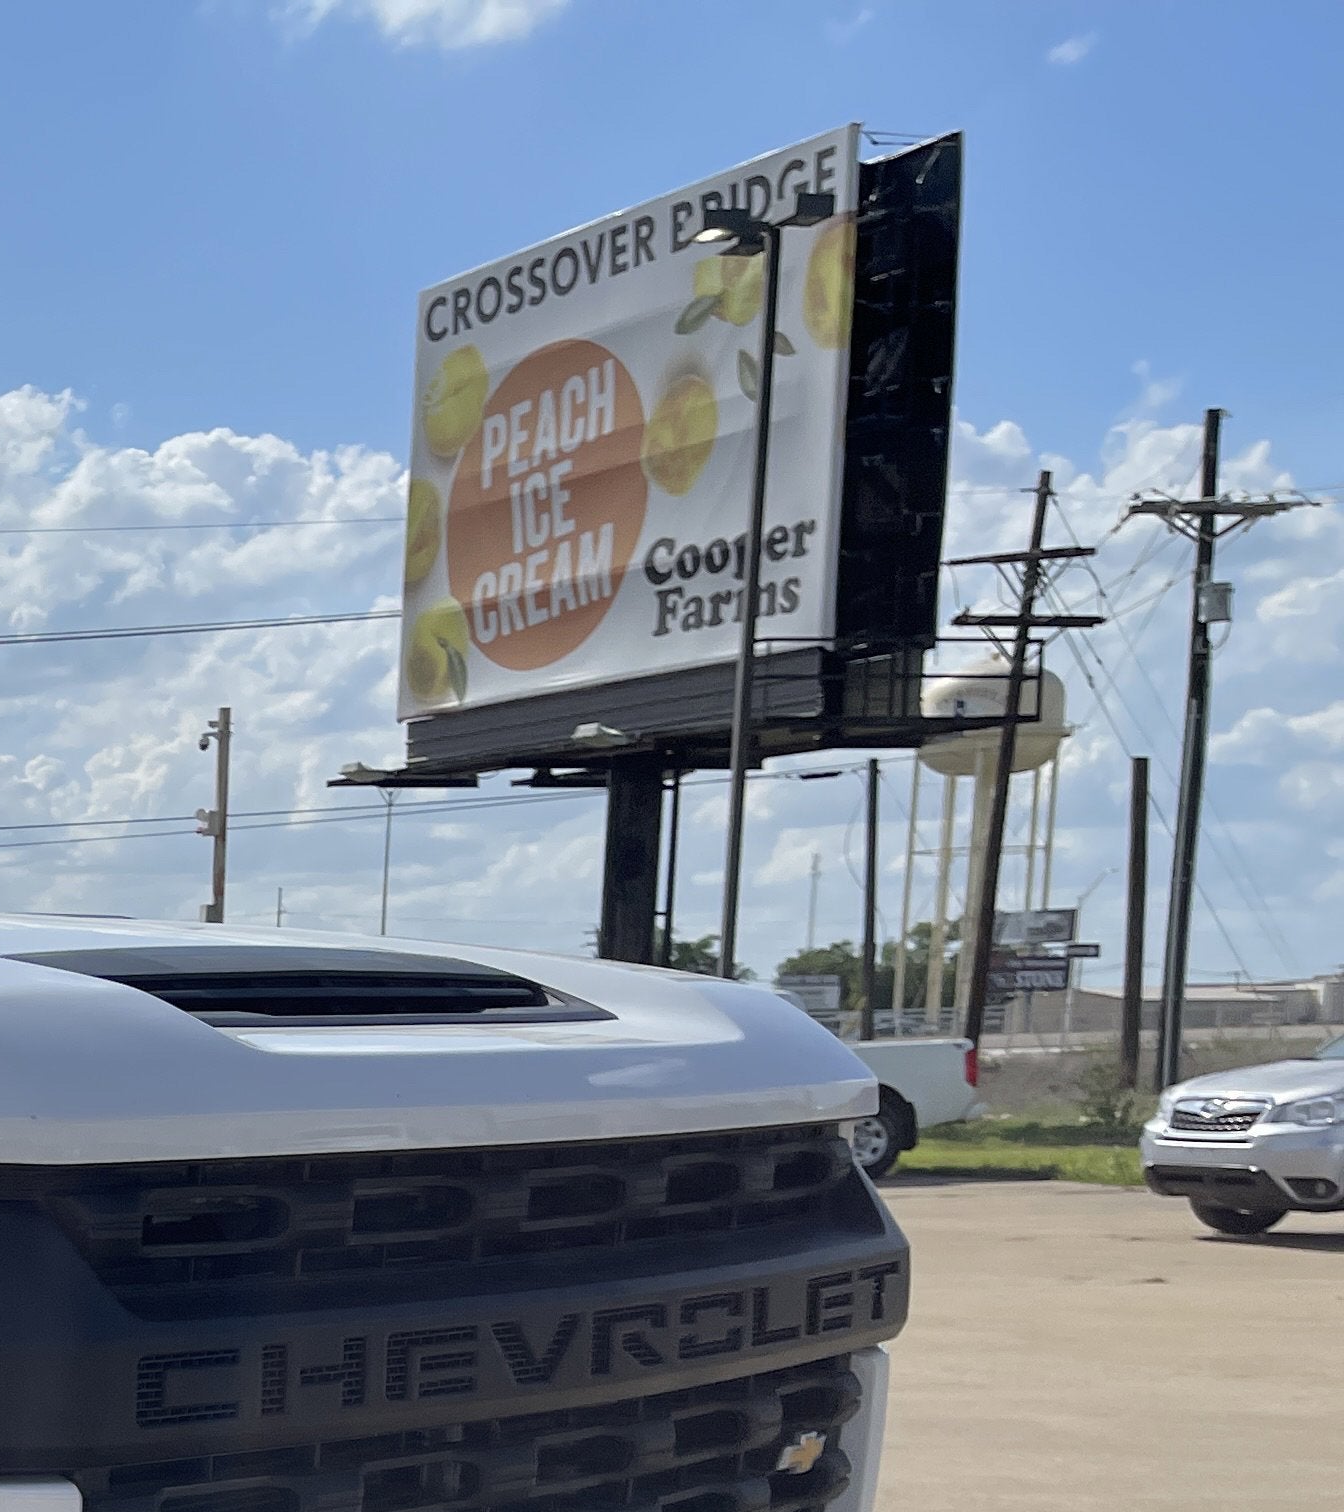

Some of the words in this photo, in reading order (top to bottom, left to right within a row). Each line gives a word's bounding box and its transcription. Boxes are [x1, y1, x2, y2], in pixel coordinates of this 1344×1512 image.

[425, 215, 657, 341] CROSSOVER
[481, 358, 616, 490] PEACH
[510, 460, 575, 554] ICE
[472, 522, 614, 645] CREAM
[136, 1260, 900, 1429] CHEVROLET
